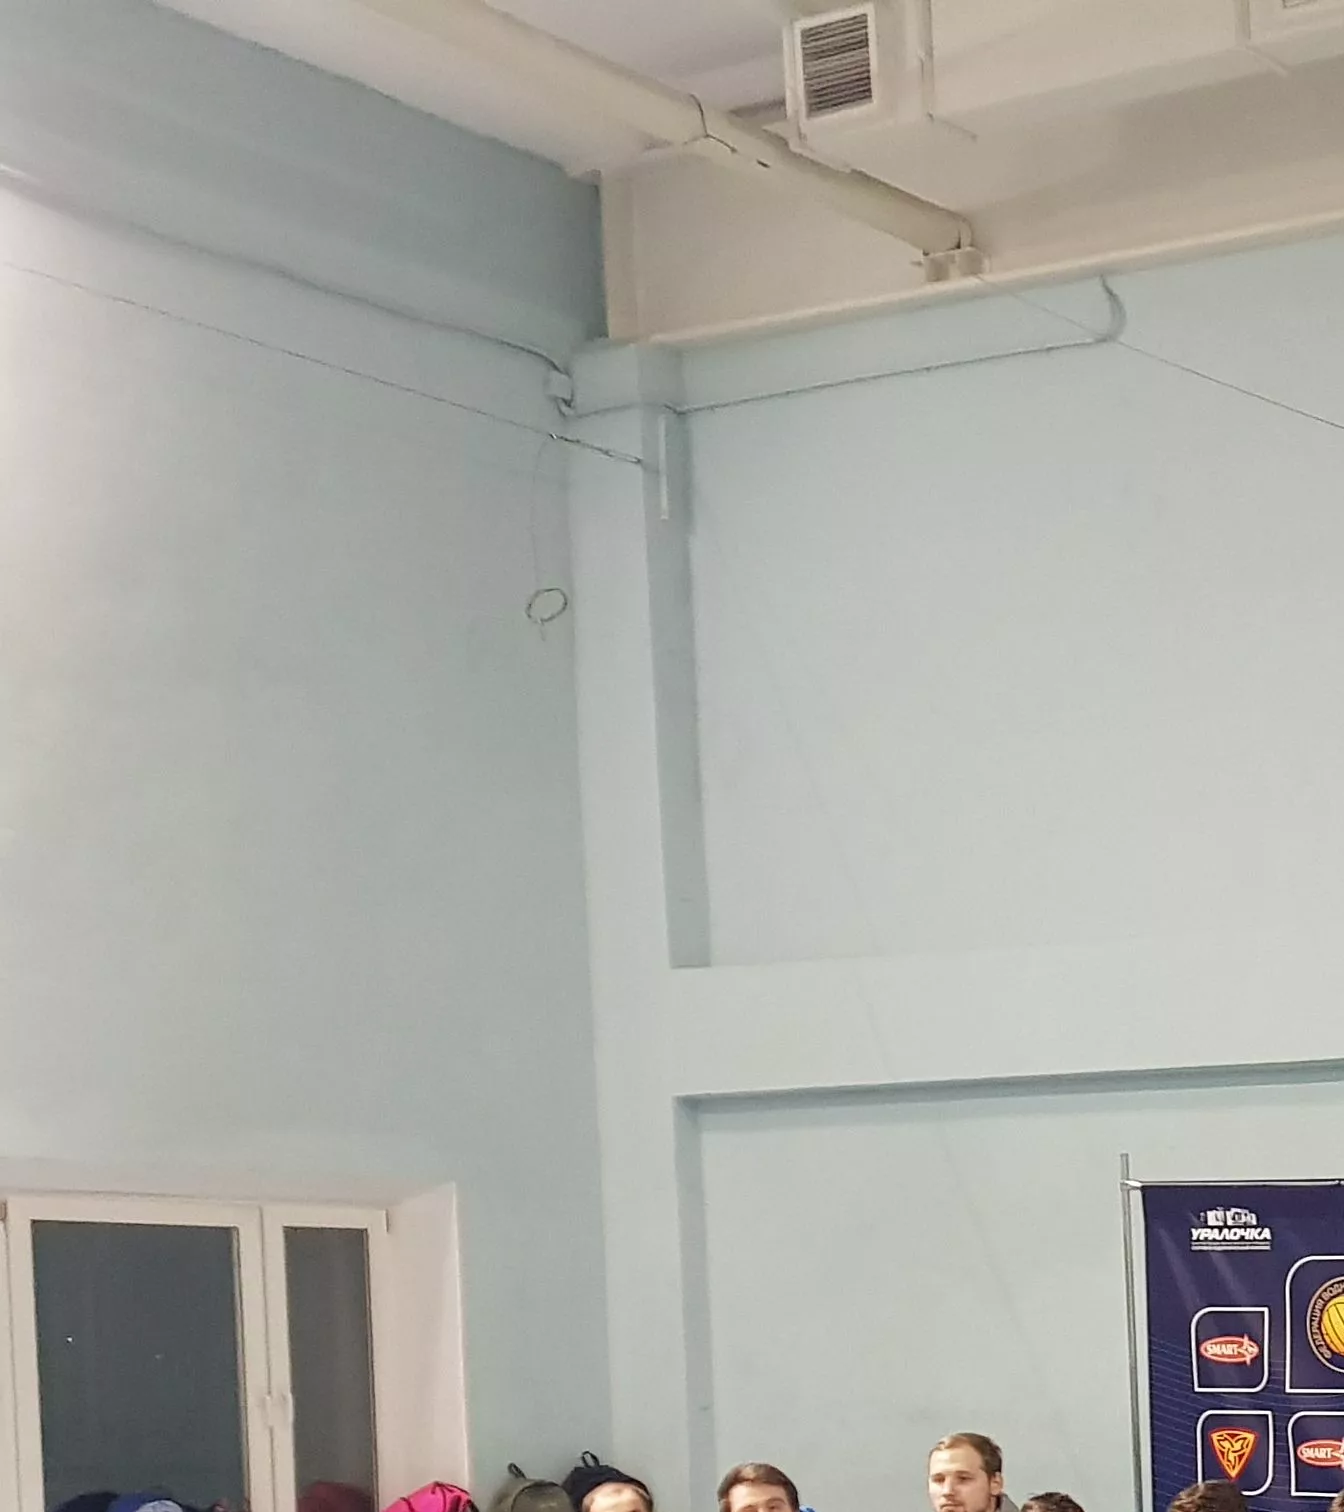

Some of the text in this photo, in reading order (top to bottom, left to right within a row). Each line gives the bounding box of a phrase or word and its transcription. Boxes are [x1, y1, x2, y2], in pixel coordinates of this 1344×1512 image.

[1190, 1227, 1272, 1241] УРАЛОЧКА
[1206, 1344, 1238, 1356] SMART
[1301, 1447, 1332, 1460] SMART
